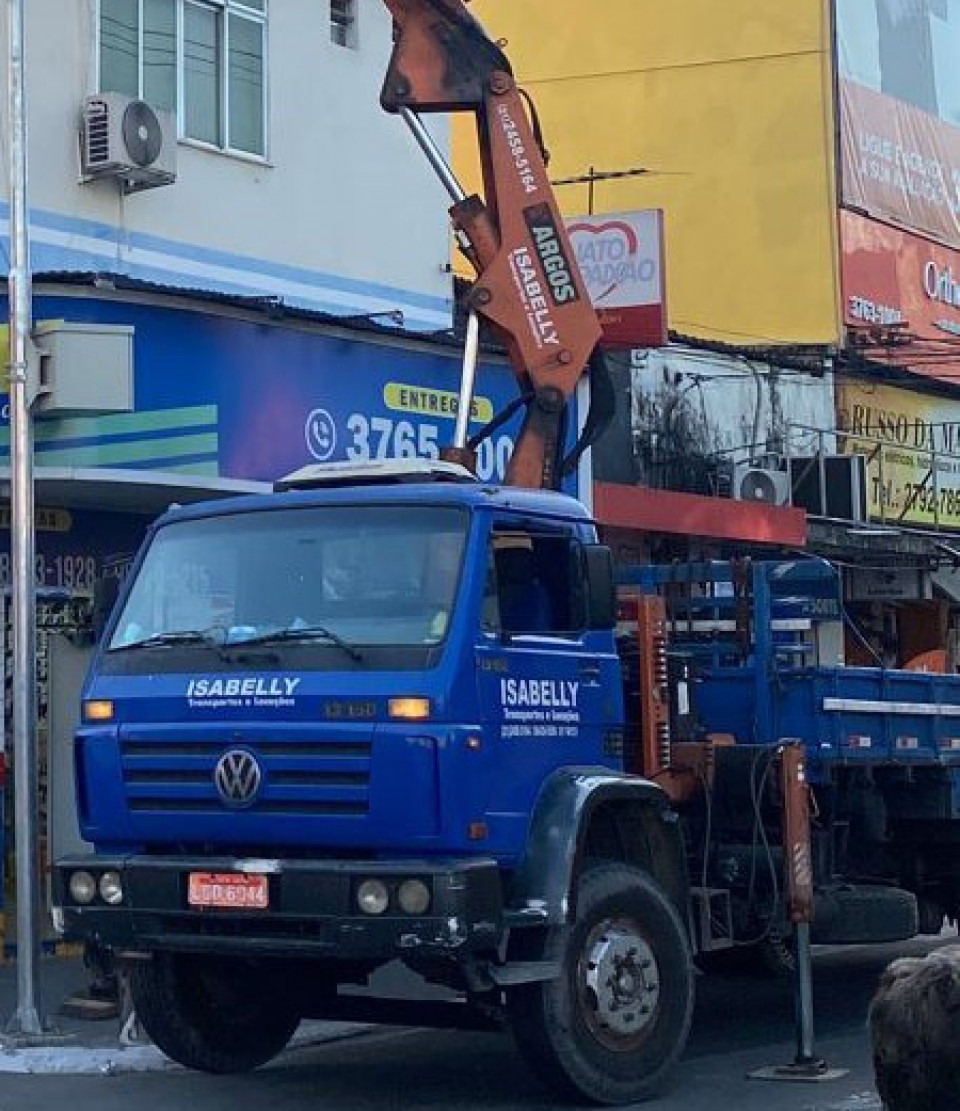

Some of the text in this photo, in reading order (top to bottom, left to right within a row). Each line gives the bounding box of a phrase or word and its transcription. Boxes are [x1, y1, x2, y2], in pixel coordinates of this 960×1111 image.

[533, 227, 575, 302] ARGOS
[514, 246, 559, 344] ISABELLY
[187, 677, 301, 697] ISABELLY
[501, 678, 579, 706] ISABELLY
